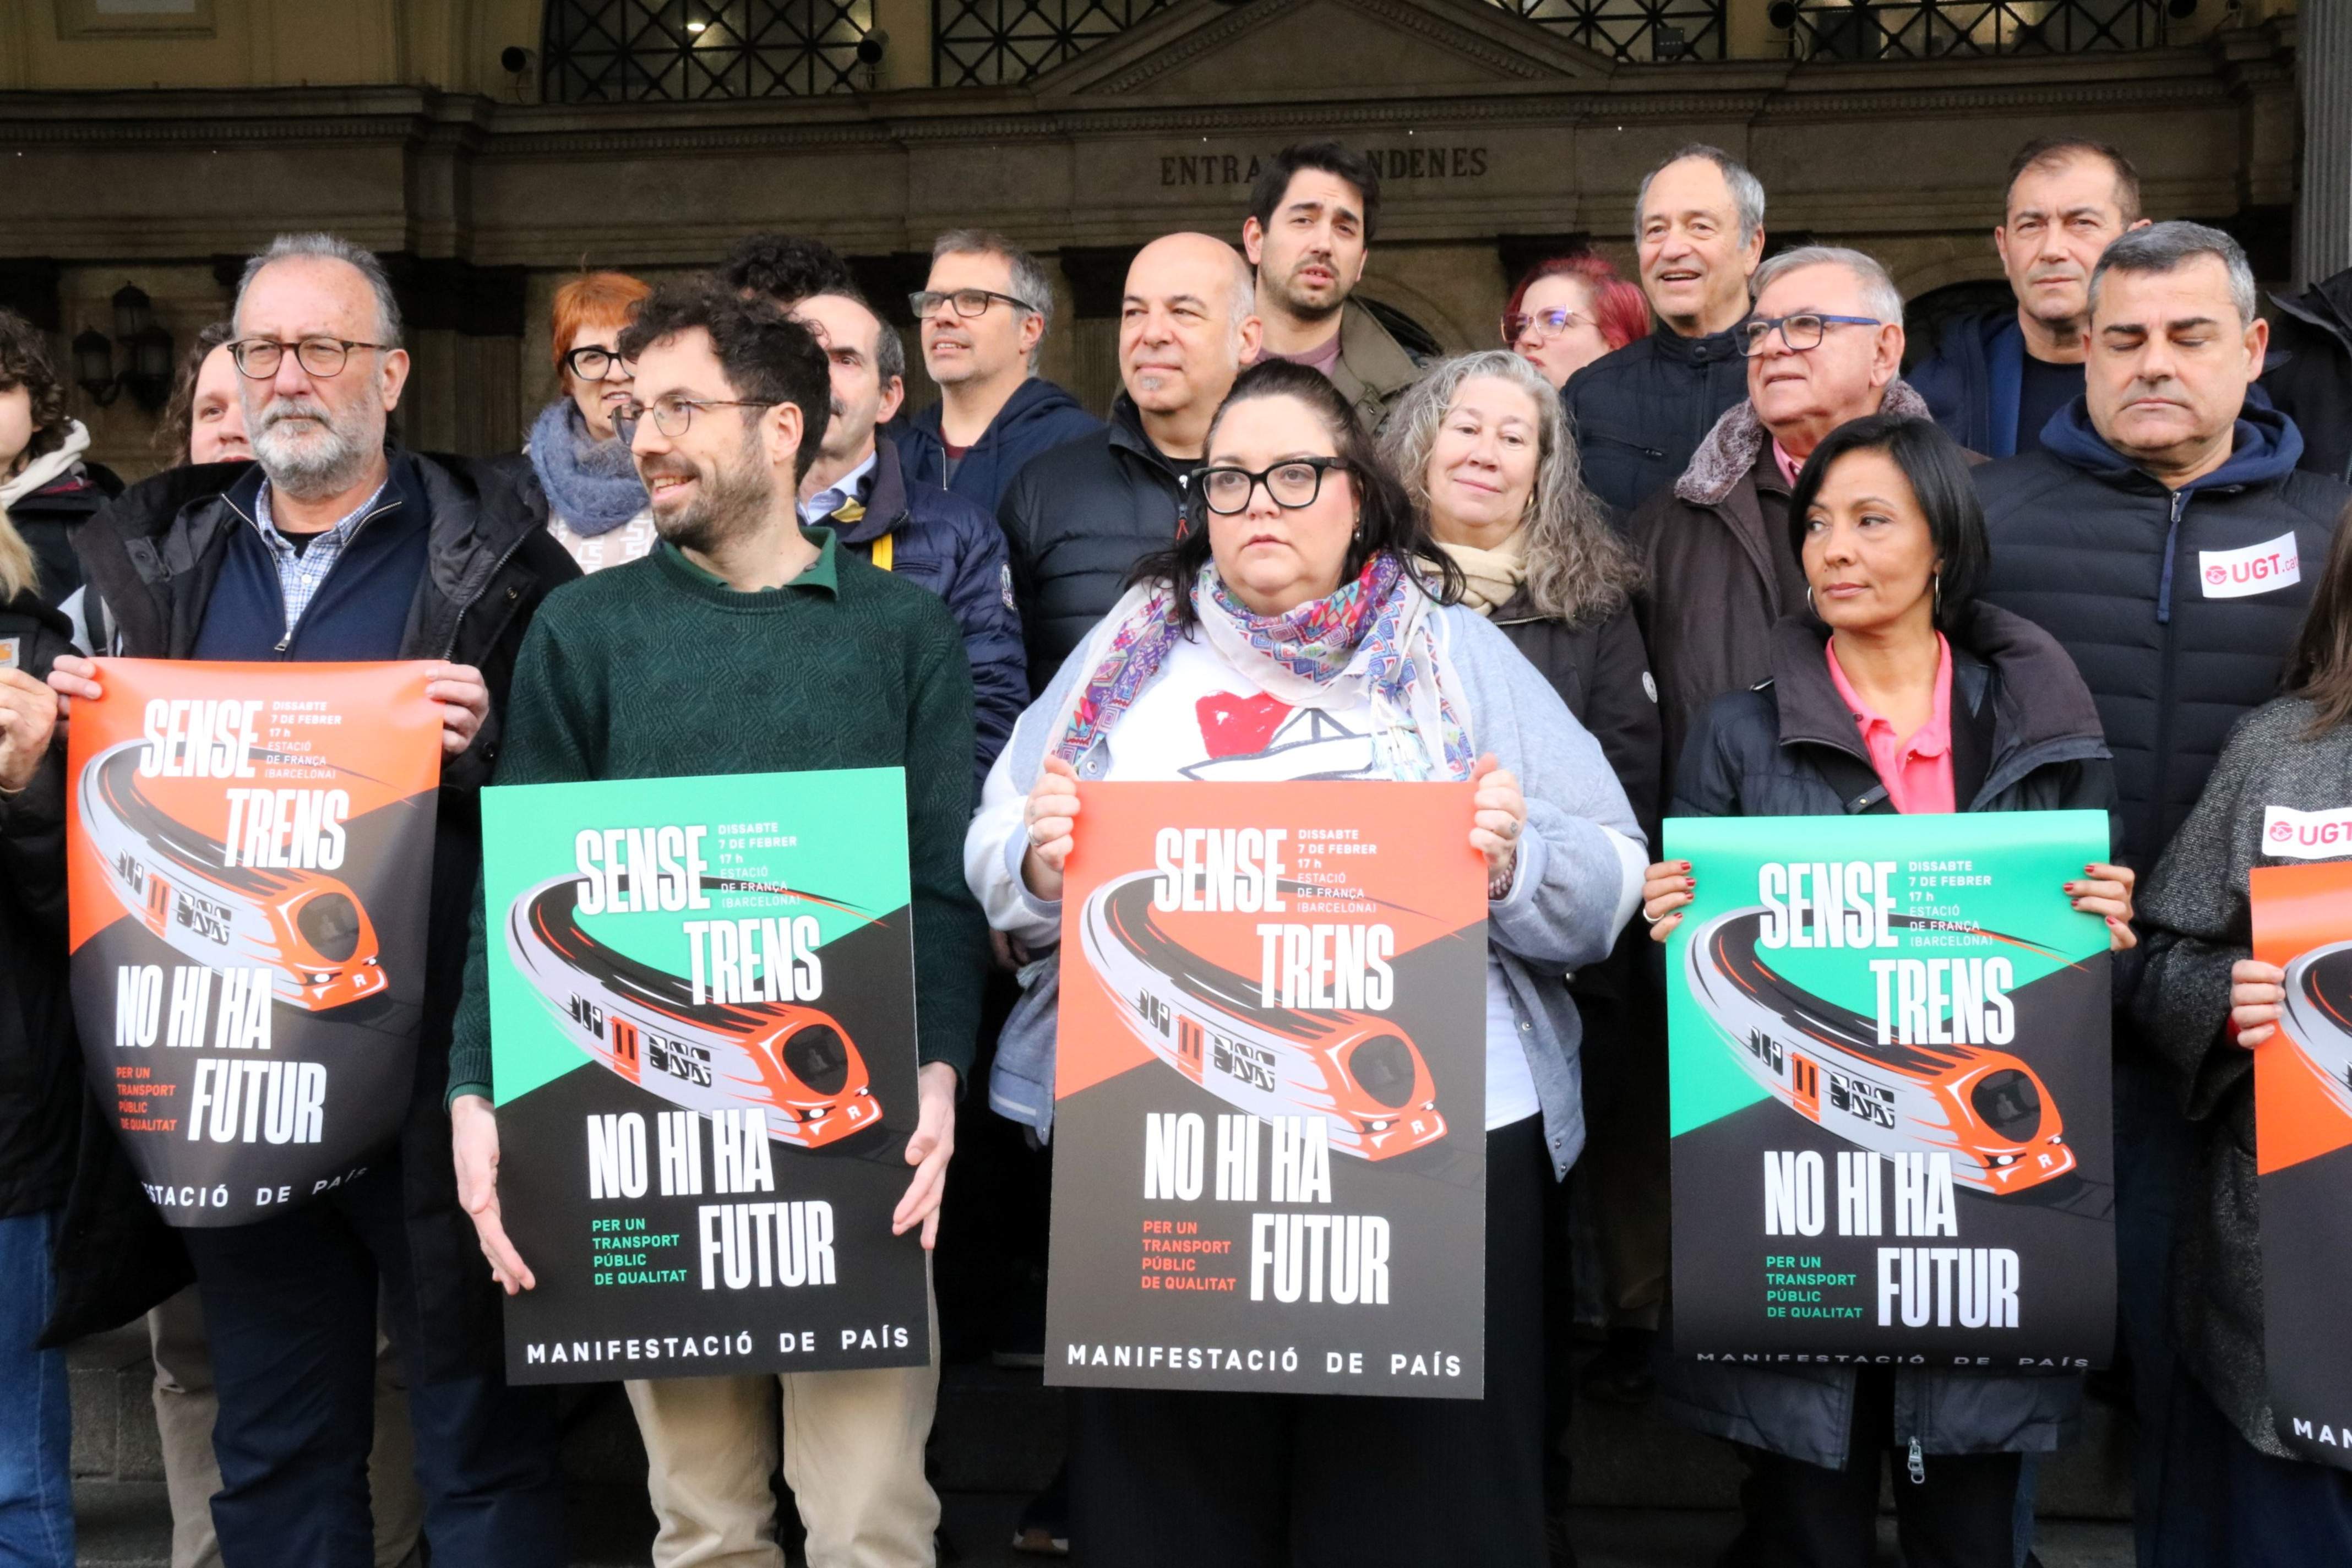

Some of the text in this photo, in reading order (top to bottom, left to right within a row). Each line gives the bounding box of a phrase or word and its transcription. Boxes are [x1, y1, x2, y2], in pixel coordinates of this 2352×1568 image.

[273, 701, 328, 711] DISSABTE
[271, 715, 342, 725] 7 DE FEBRER
[139, 699, 264, 778] SENSE
[269, 728, 291, 737] 17 h
[268, 741, 312, 752] ESTACIÓ
[266, 755, 326, 766] DE FRANÇA
[265, 769, 336, 779] (BARCELONA)
[224, 788, 350, 870] TRENS
[718, 822, 778, 835] DISSABTE
[1298, 830, 1359, 840] DISSABTE
[718, 836, 797, 849] 7 DE FEBRER
[1298, 844, 1377, 854] 7 DE FEBRER
[720, 853, 743, 864] 17 h
[1298, 858, 1321, 868] 17 h
[575, 825, 711, 918] SENSE
[720, 865, 768, 878] ESTACIÓ
[1154, 826, 1288, 914] SENSE
[1909, 861, 1973, 872] DISSABTE
[1298, 872, 1346, 883] ESTACIÓ
[1908, 875, 1991, 886] 7 DE FEBRER
[721, 881, 788, 894] DE FRANÇA
[1298, 888, 1364, 900] DE FRANÇA
[722, 895, 801, 908] (BARCELONA)
[1909, 891, 1934, 901] 17 h
[1297, 902, 1376, 913] (BARCELONA)
[1757, 861, 1898, 950] SENSE
[1909, 904, 1960, 917] ESTACIÓ
[1910, 921, 1980, 933] DE FRANÇA
[1910, 935, 1993, 946] (BARCELONA)
[683, 916, 823, 1005] TRENS
[1257, 924, 1395, 1011] TRENS
[352, 973, 367, 988] R
[116, 965, 273, 1049] NO HI HA
[1869, 957, 2015, 1046] TRENS
[116, 1066, 150, 1078] PER UN
[117, 1084, 176, 1096] TRANSPORT
[118, 1099, 148, 1113] PÚBLIC
[188, 1058, 327, 1145] FUTUR
[846, 1106, 862, 1120] R
[120, 1118, 177, 1131] DE QUALITAT
[1411, 1119, 1426, 1134] R
[586, 1107, 775, 1200] NO HI HA
[1144, 1113, 1332, 1204] NO HI HA
[2038, 1153, 2052, 1168] R
[255, 1186, 291, 1206] DE
[1764, 1150, 1958, 1237] NO HI HA
[592, 1218, 645, 1232] PER UN
[1144, 1221, 1197, 1234] PER UN
[592, 1234, 679, 1250] TRANSPORT
[698, 1200, 836, 1291] FUTUR
[1142, 1239, 1232, 1254] TRANSPORT
[594, 1253, 646, 1267] PÚBLIC
[1142, 1256, 1196, 1271] PÚBLIC
[1250, 1212, 1390, 1305] FUTUR
[1766, 1256, 1821, 1268] PER UN
[595, 1270, 687, 1286] DE QUALITAT
[1141, 1276, 1237, 1291] DE QUALITAT
[1766, 1273, 1856, 1286] TRANSPORT
[1767, 1288, 1821, 1302] PÚBLIC
[1877, 1248, 2019, 1329] FUTUR
[1767, 1307, 1863, 1318] DE QUALITAT
[527, 1323, 908, 1364] MANIFESTACIÓ DE PAÍS
[1067, 1344, 1462, 1378] MANIFESTACIÓ DE PAÍS
[1697, 1353, 2089, 1368] MANIFESTACIÓ DE PAÍS
